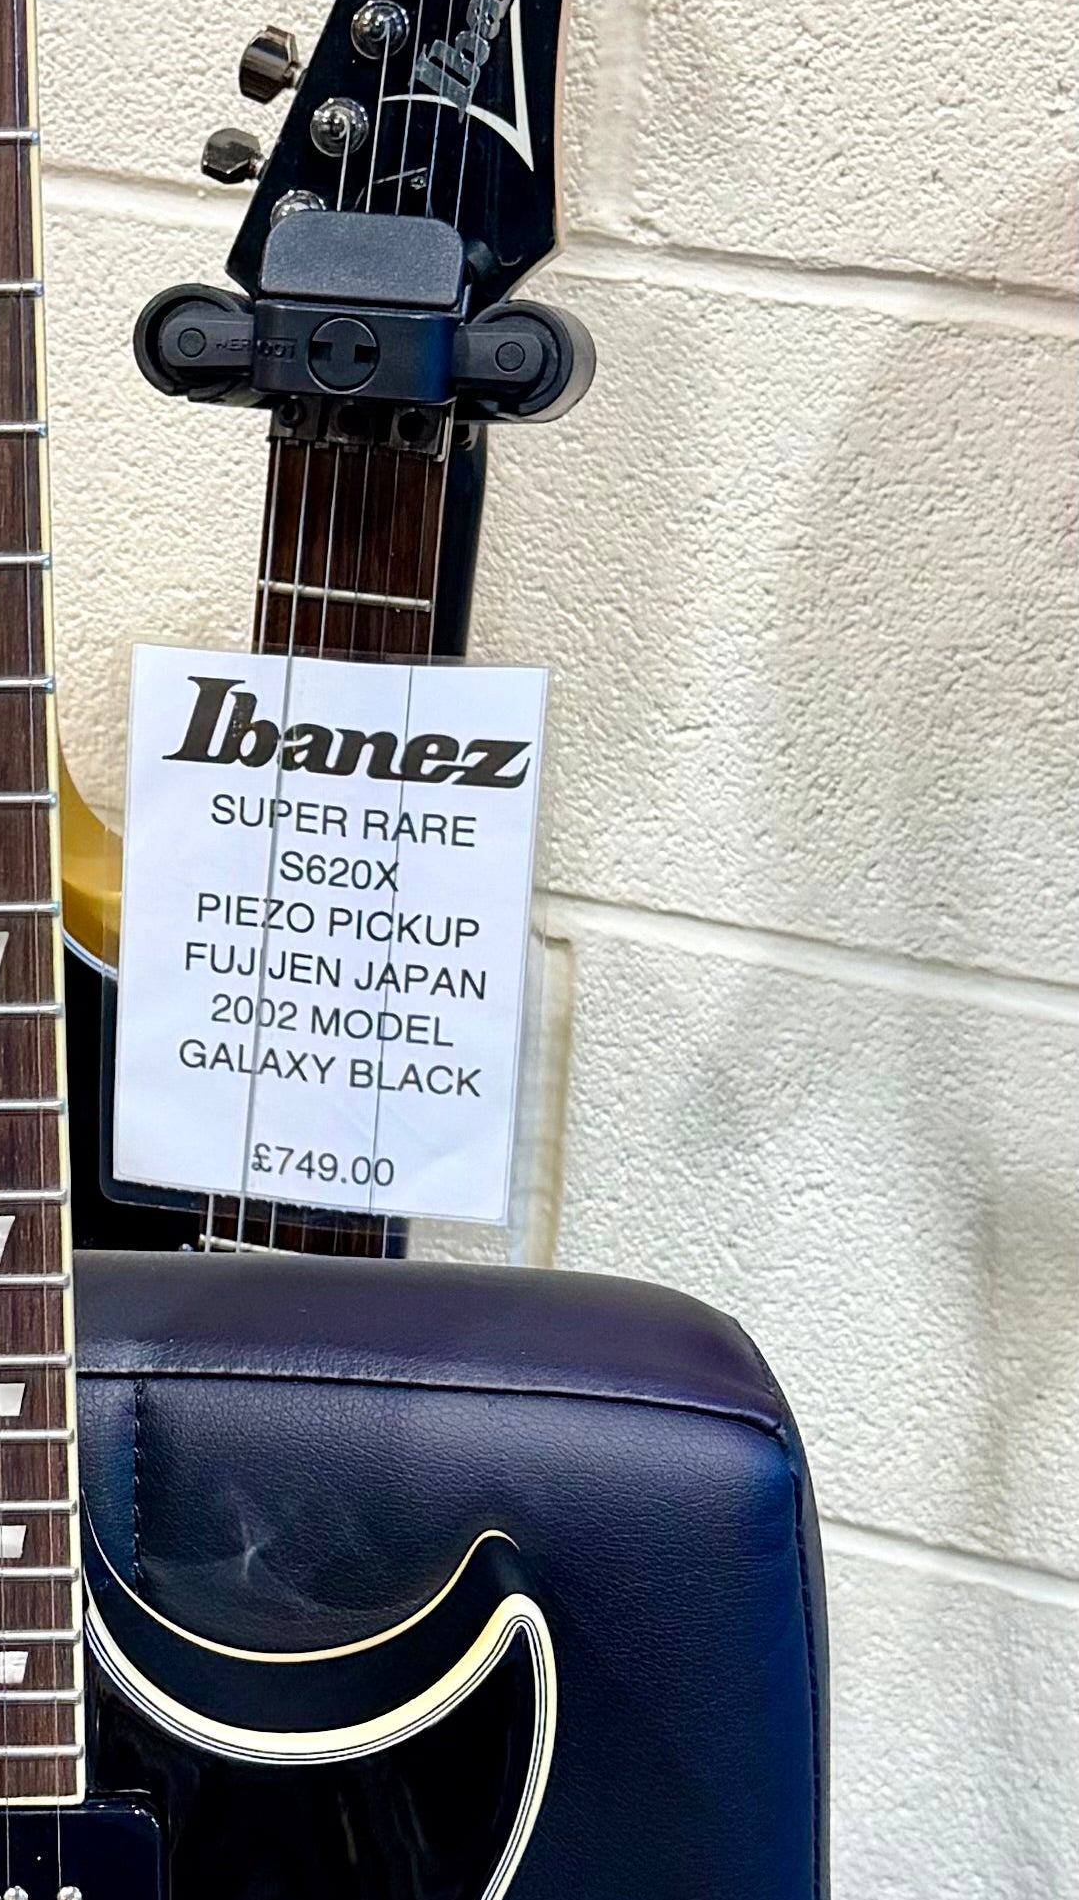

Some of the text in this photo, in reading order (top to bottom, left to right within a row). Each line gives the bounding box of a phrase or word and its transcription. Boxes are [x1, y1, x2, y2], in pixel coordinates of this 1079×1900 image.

[162, 676, 533, 789] Ibanez
[210, 793, 477, 848] SUPER RARE
[279, 851, 400, 892] S620X
[196, 894, 481, 948] PIEZO PICKUP
[184, 941, 487, 1000] FUJJEN JAPAN
[211, 994, 454, 1047] 2002 MODEL
[178, 1039, 482, 1098] GALAXY BLACK
[252, 1142, 395, 1187] £749.00
